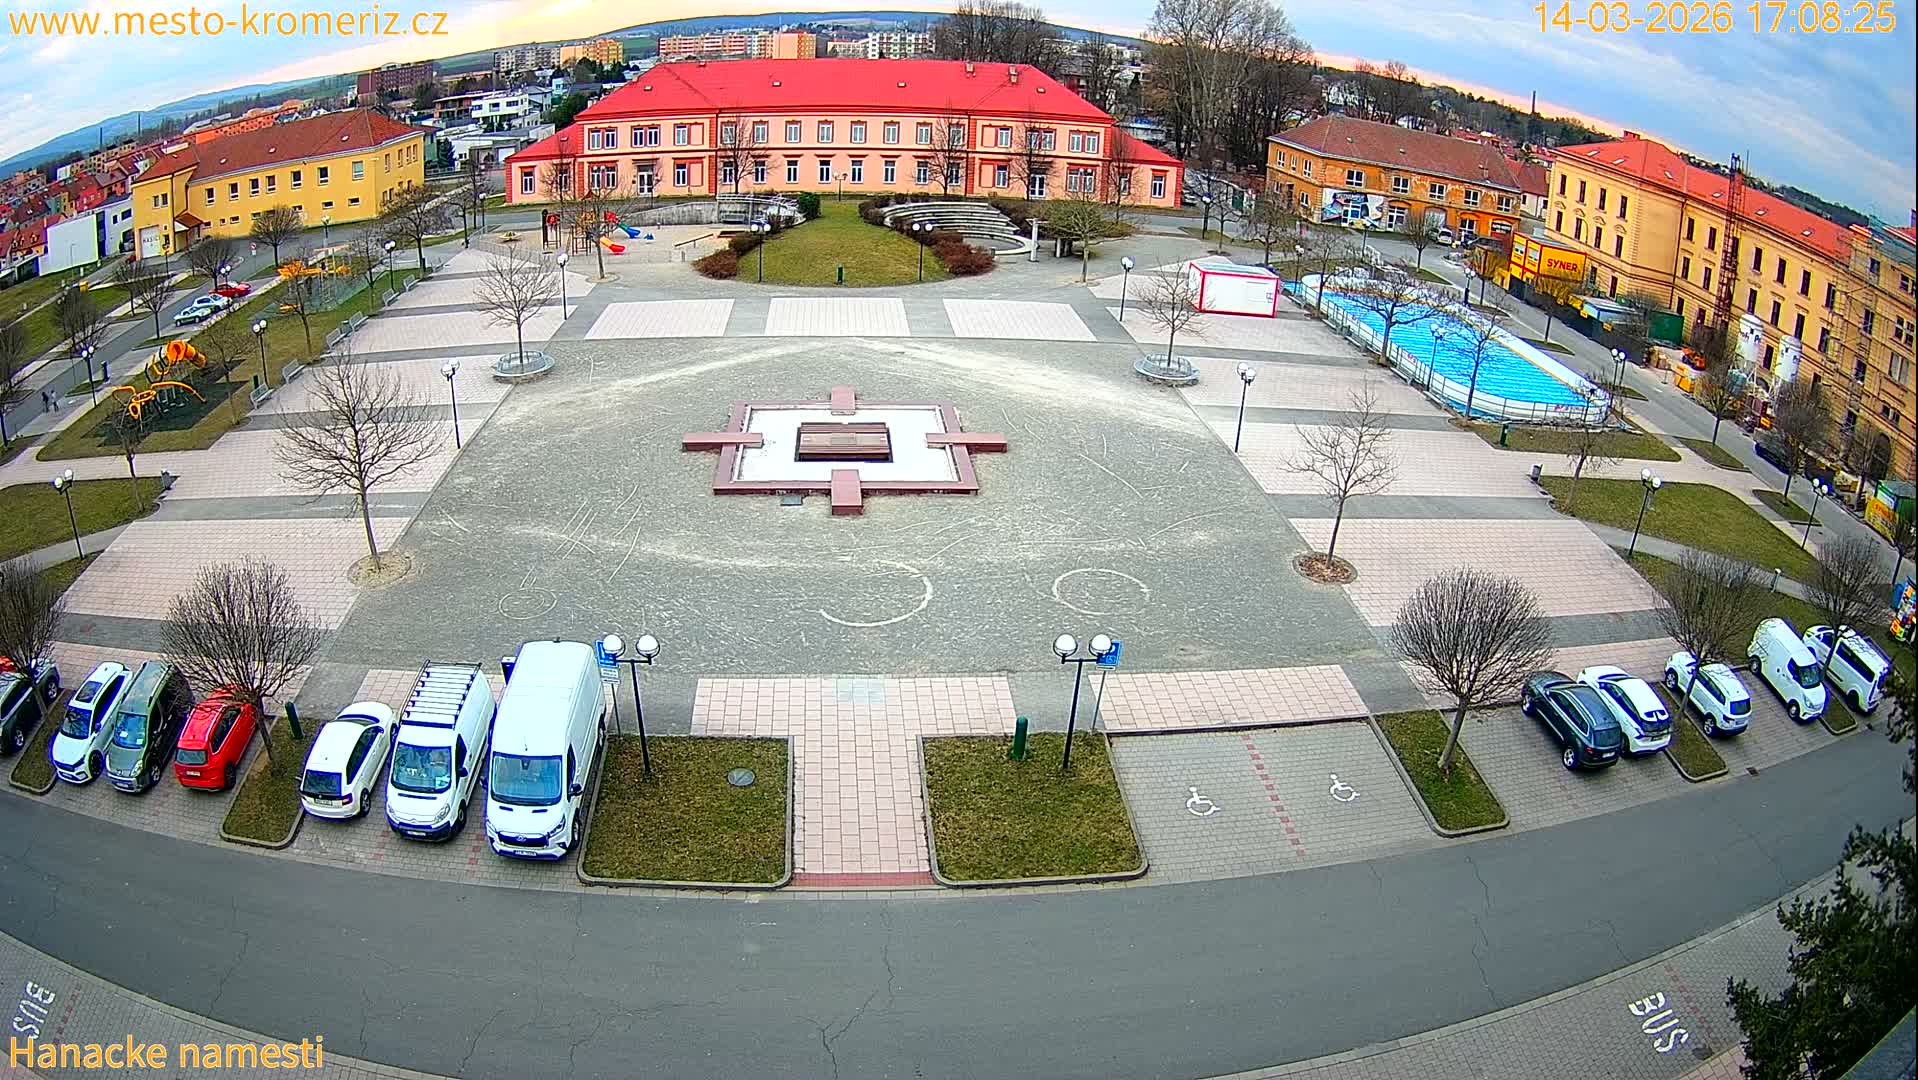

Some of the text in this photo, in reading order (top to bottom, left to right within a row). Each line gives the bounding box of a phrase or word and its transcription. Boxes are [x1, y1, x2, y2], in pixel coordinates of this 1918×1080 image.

[1546, 258, 1578, 273] SYNER
[12, 981, 56, 1039] BUS
[1628, 991, 1689, 1053] BUS
